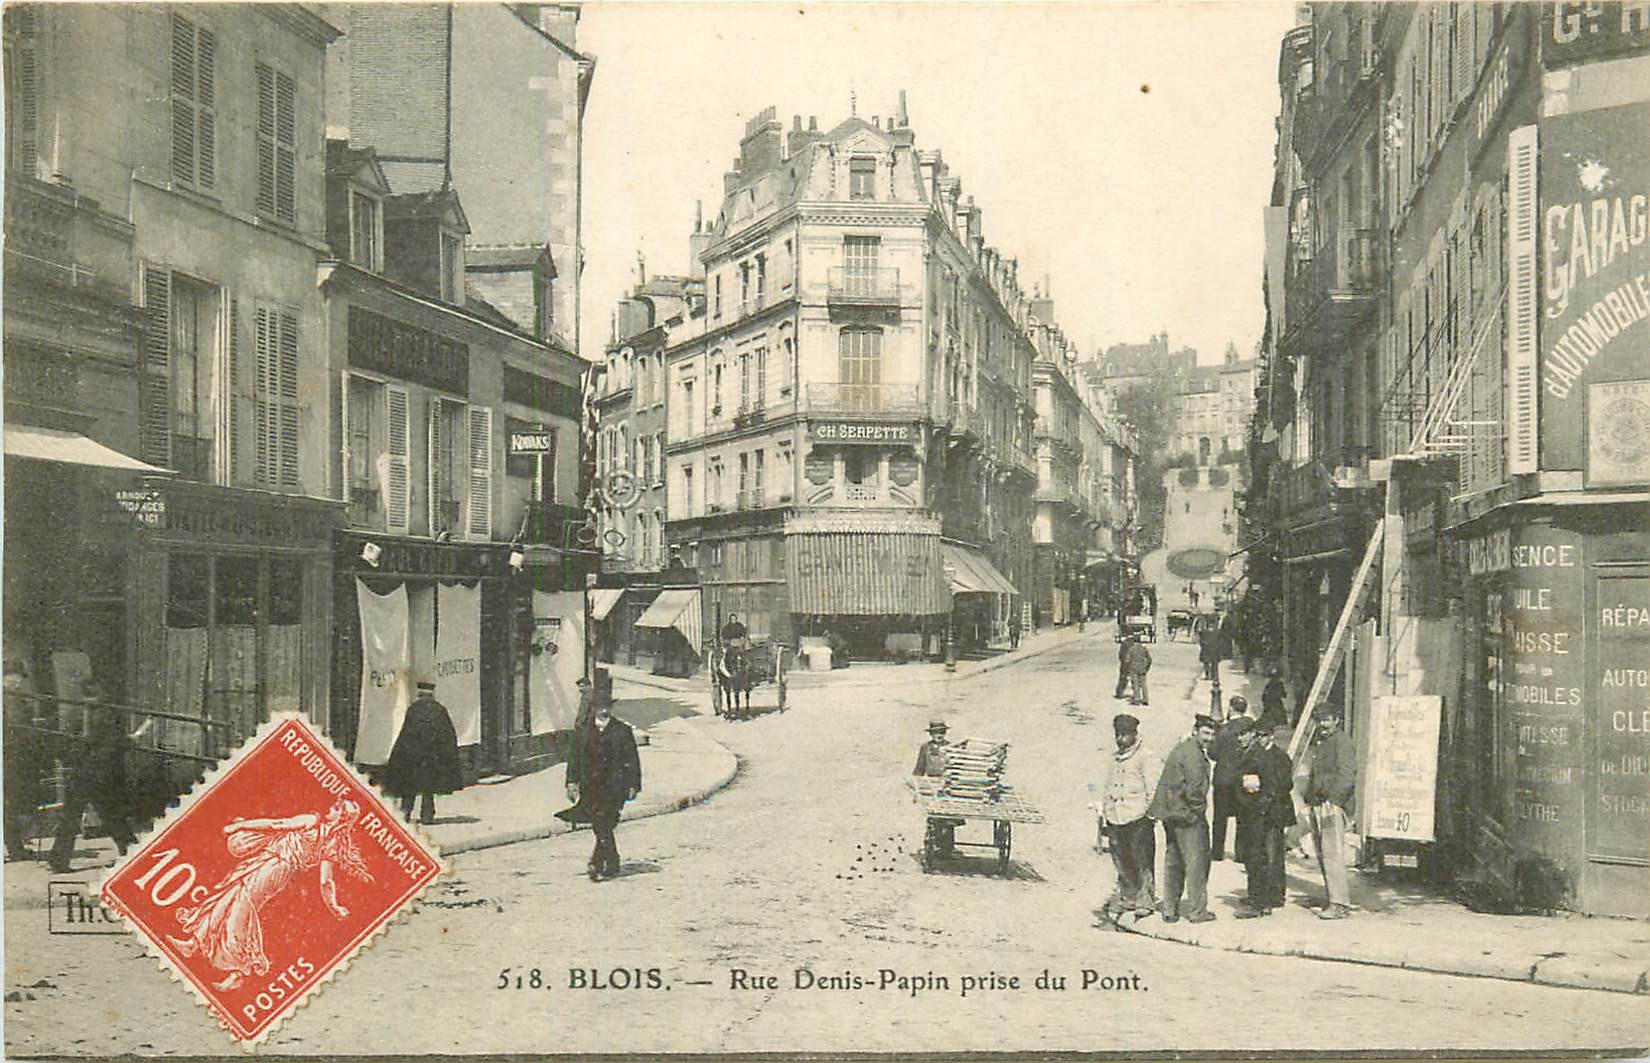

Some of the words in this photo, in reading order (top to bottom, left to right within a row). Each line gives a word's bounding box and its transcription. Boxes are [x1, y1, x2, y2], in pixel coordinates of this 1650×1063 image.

[1545, 194, 1650, 318] GARAG
[839, 424, 908, 440] SERPETTE
[1602, 668, 1648, 687] AUTO
